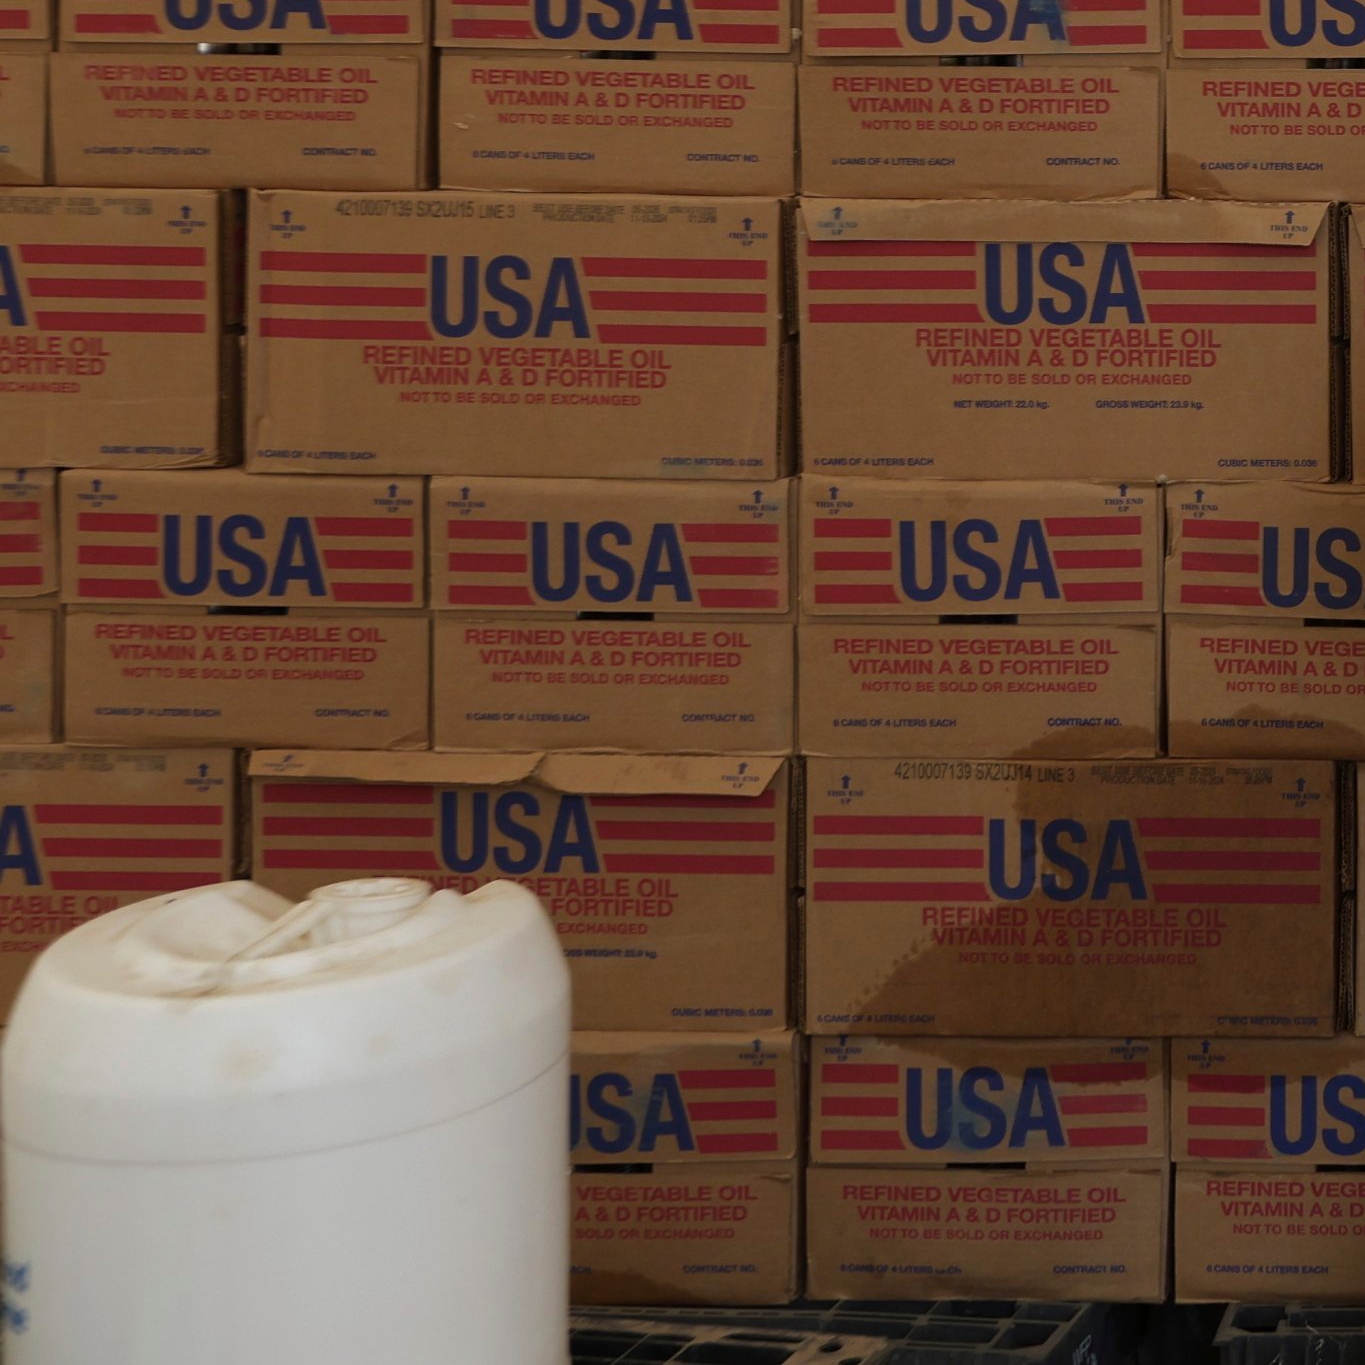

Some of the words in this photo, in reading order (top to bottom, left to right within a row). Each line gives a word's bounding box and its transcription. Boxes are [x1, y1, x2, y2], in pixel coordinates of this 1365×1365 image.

[433, 257, 588, 337] USA
[900, 520, 1060, 601] USA
[989, 820, 1146, 900] USA
